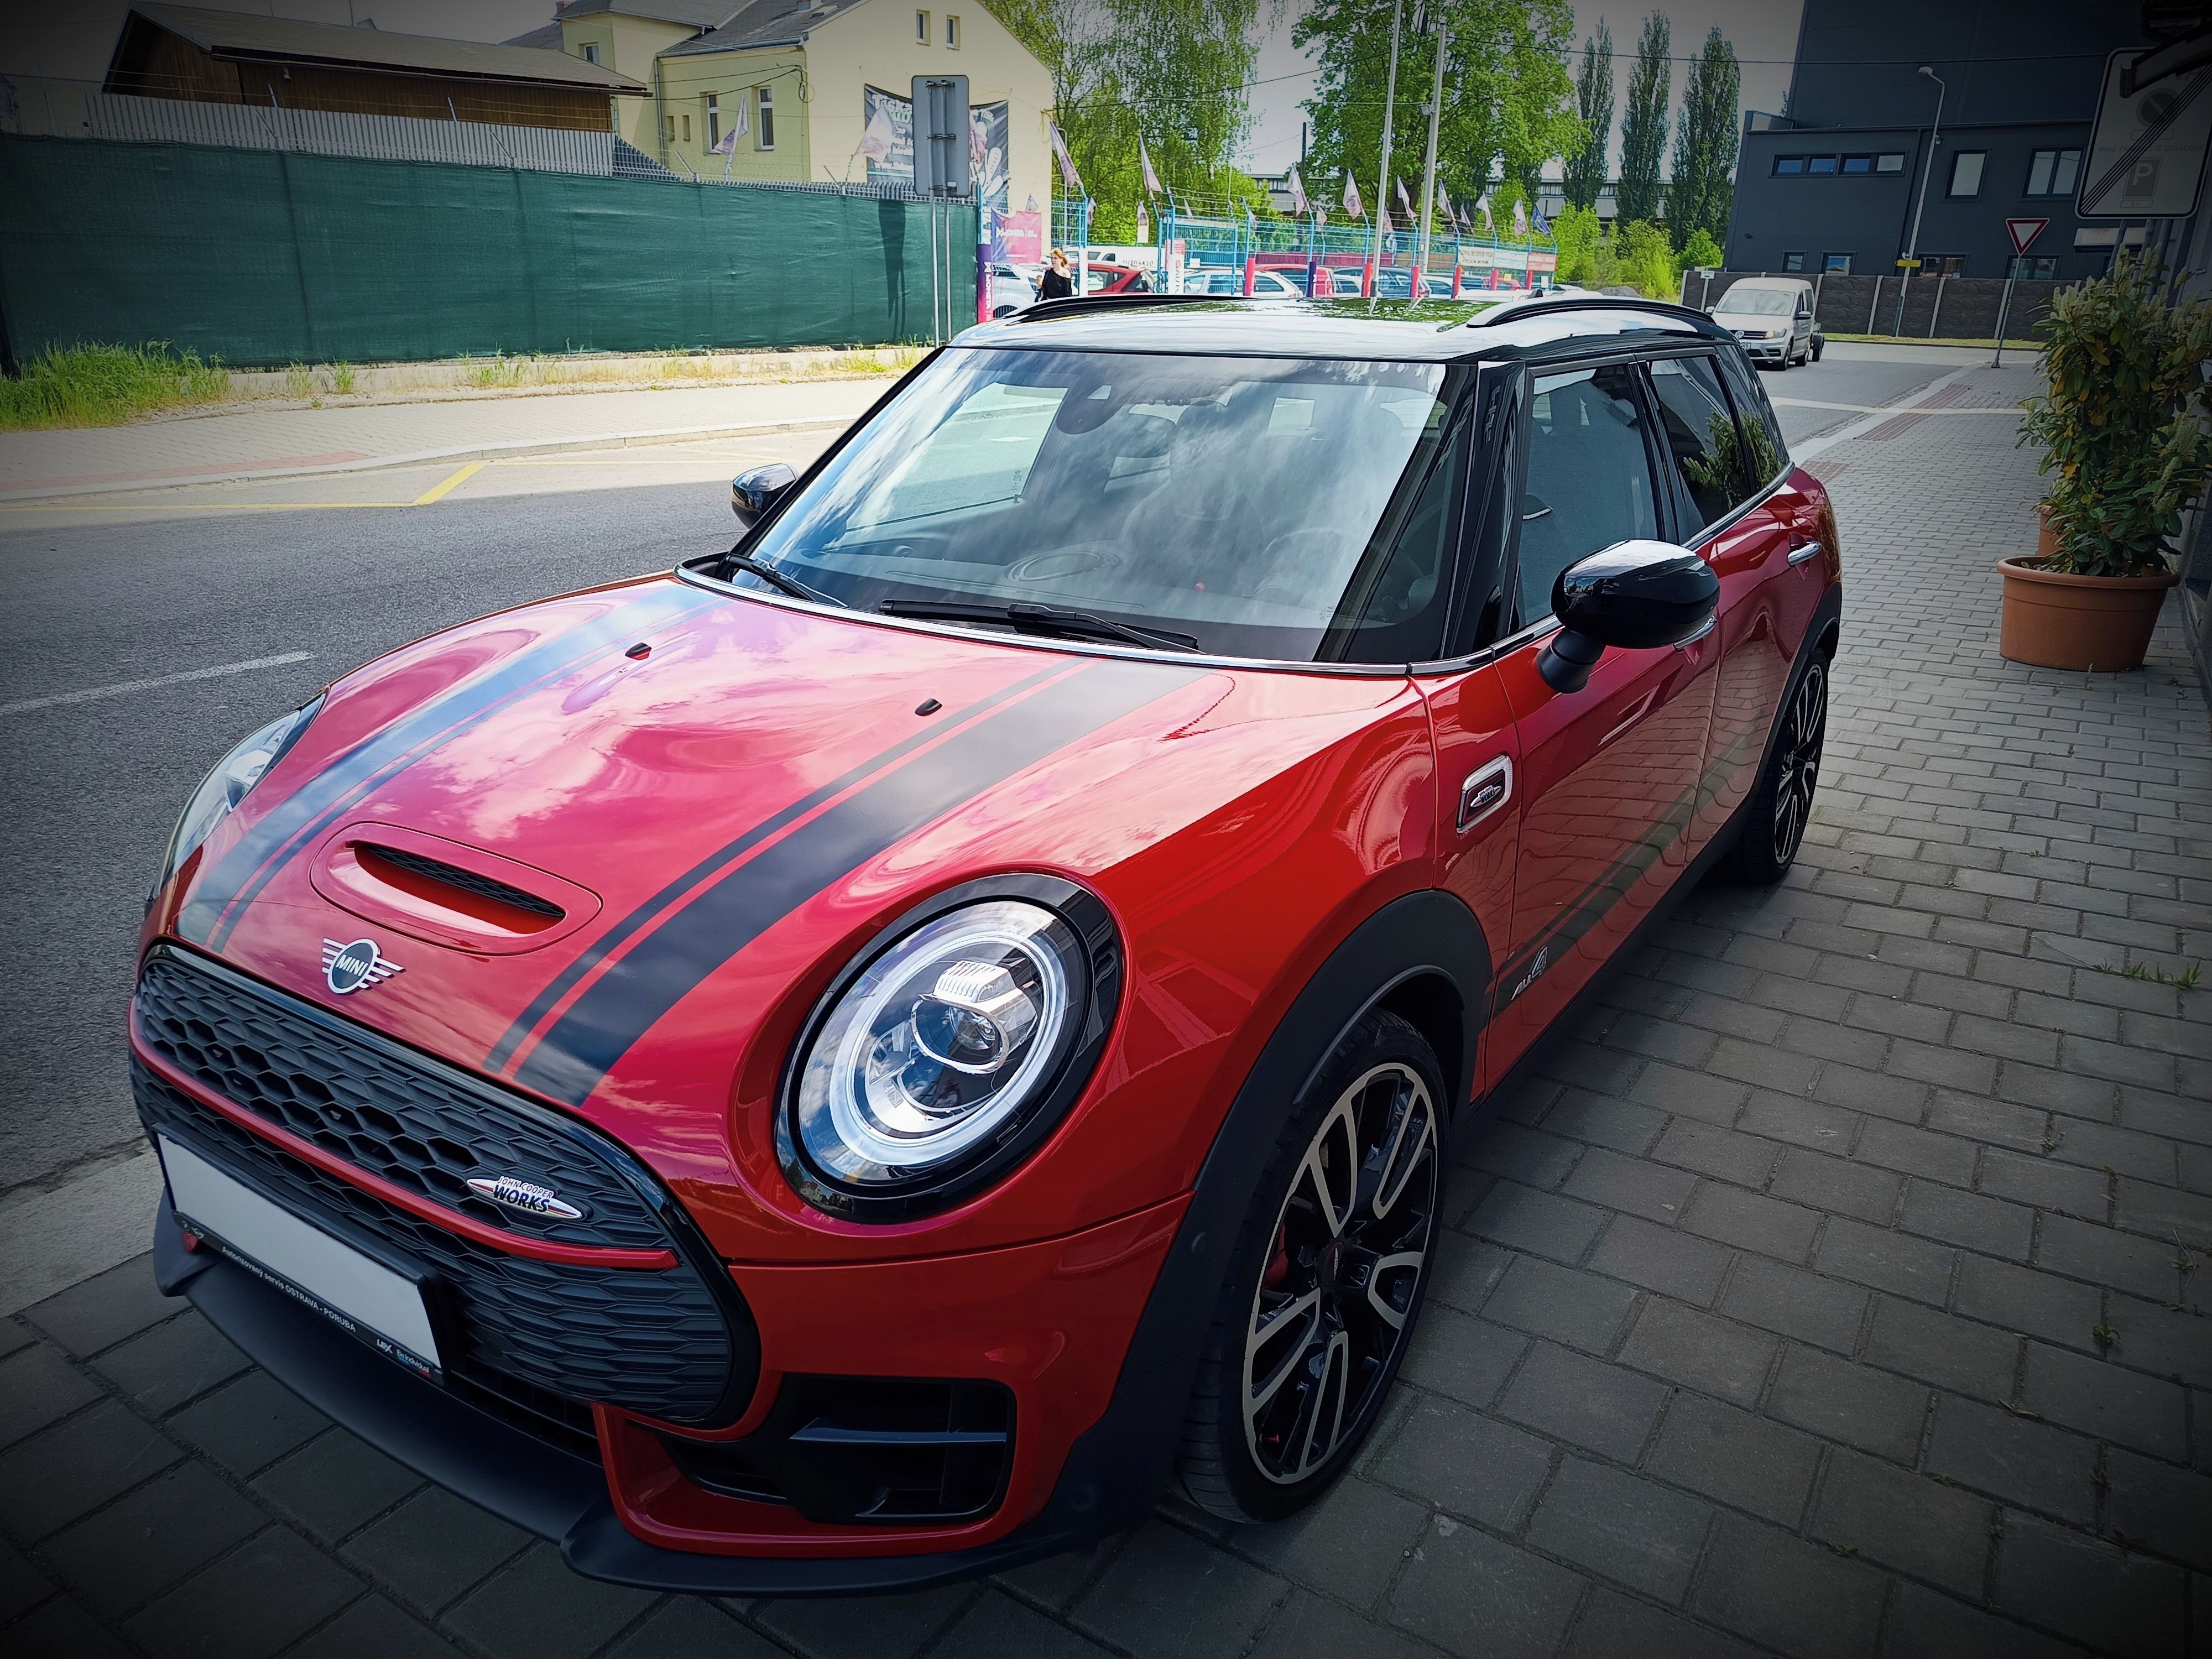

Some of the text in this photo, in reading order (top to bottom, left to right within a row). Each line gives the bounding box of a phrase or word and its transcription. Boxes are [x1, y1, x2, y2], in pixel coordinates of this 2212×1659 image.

[2132, 162, 2153, 186] P
[1480, 789, 1495, 804] WORKS
[336, 954, 368, 977] MINI
[493, 1184, 550, 1213] WORKS
[498, 1177, 553, 1198] JOHN COOPER
[264, 1272, 285, 1290] servis
[285, 1284, 319, 1311] OSTRAVA
[324, 1307, 356, 1332] PORUBA
[377, 1338, 393, 1354] LEX
